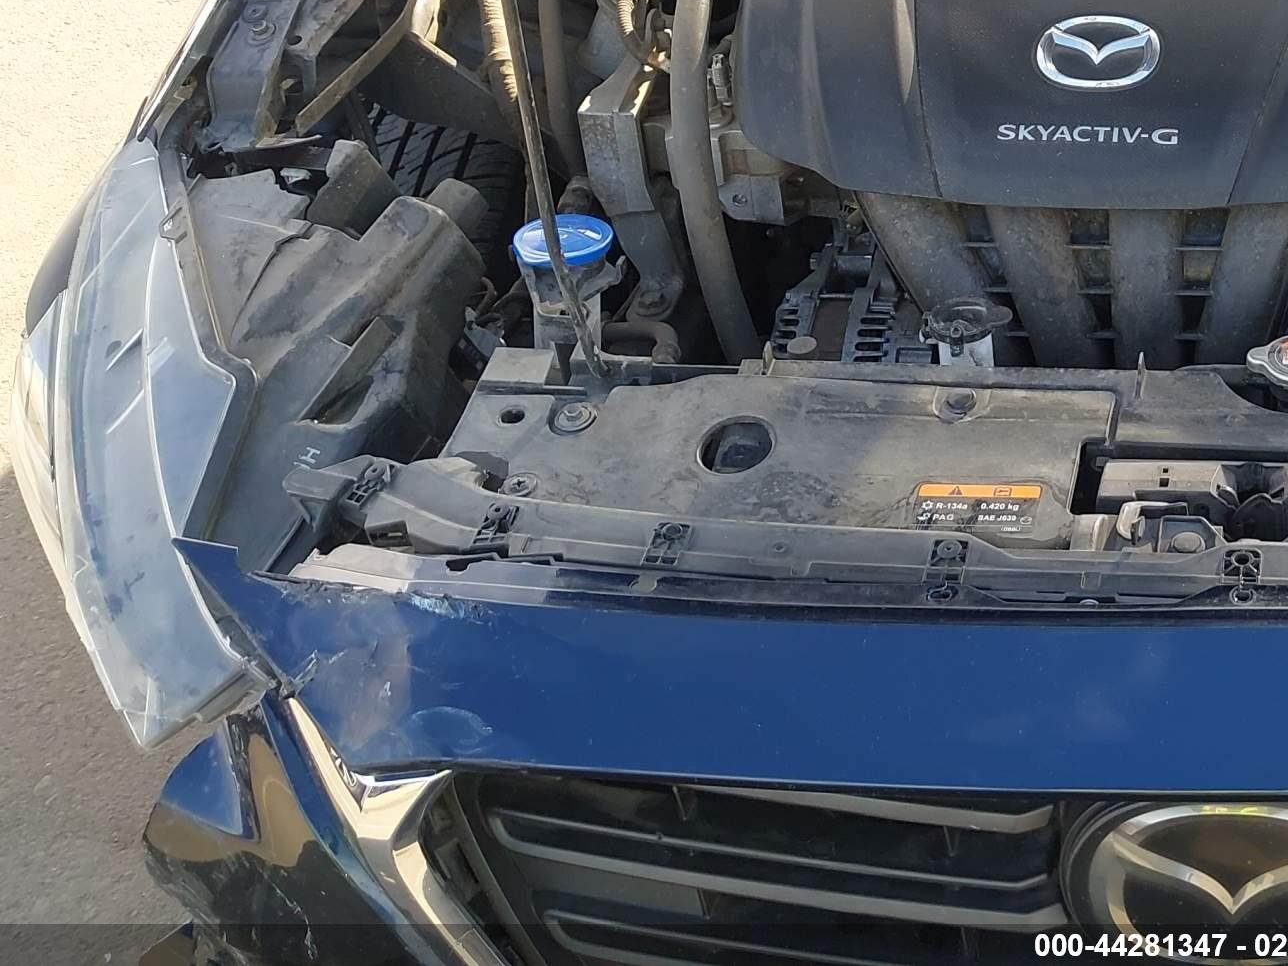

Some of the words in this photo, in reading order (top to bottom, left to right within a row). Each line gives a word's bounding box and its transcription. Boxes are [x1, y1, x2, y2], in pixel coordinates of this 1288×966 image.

[997, 124, 1179, 145] SKYACTIV-G
[935, 502, 968, 510] R-134a
[980, 502, 1006, 510] 0.420
[1007, 501, 1020, 511] kg
